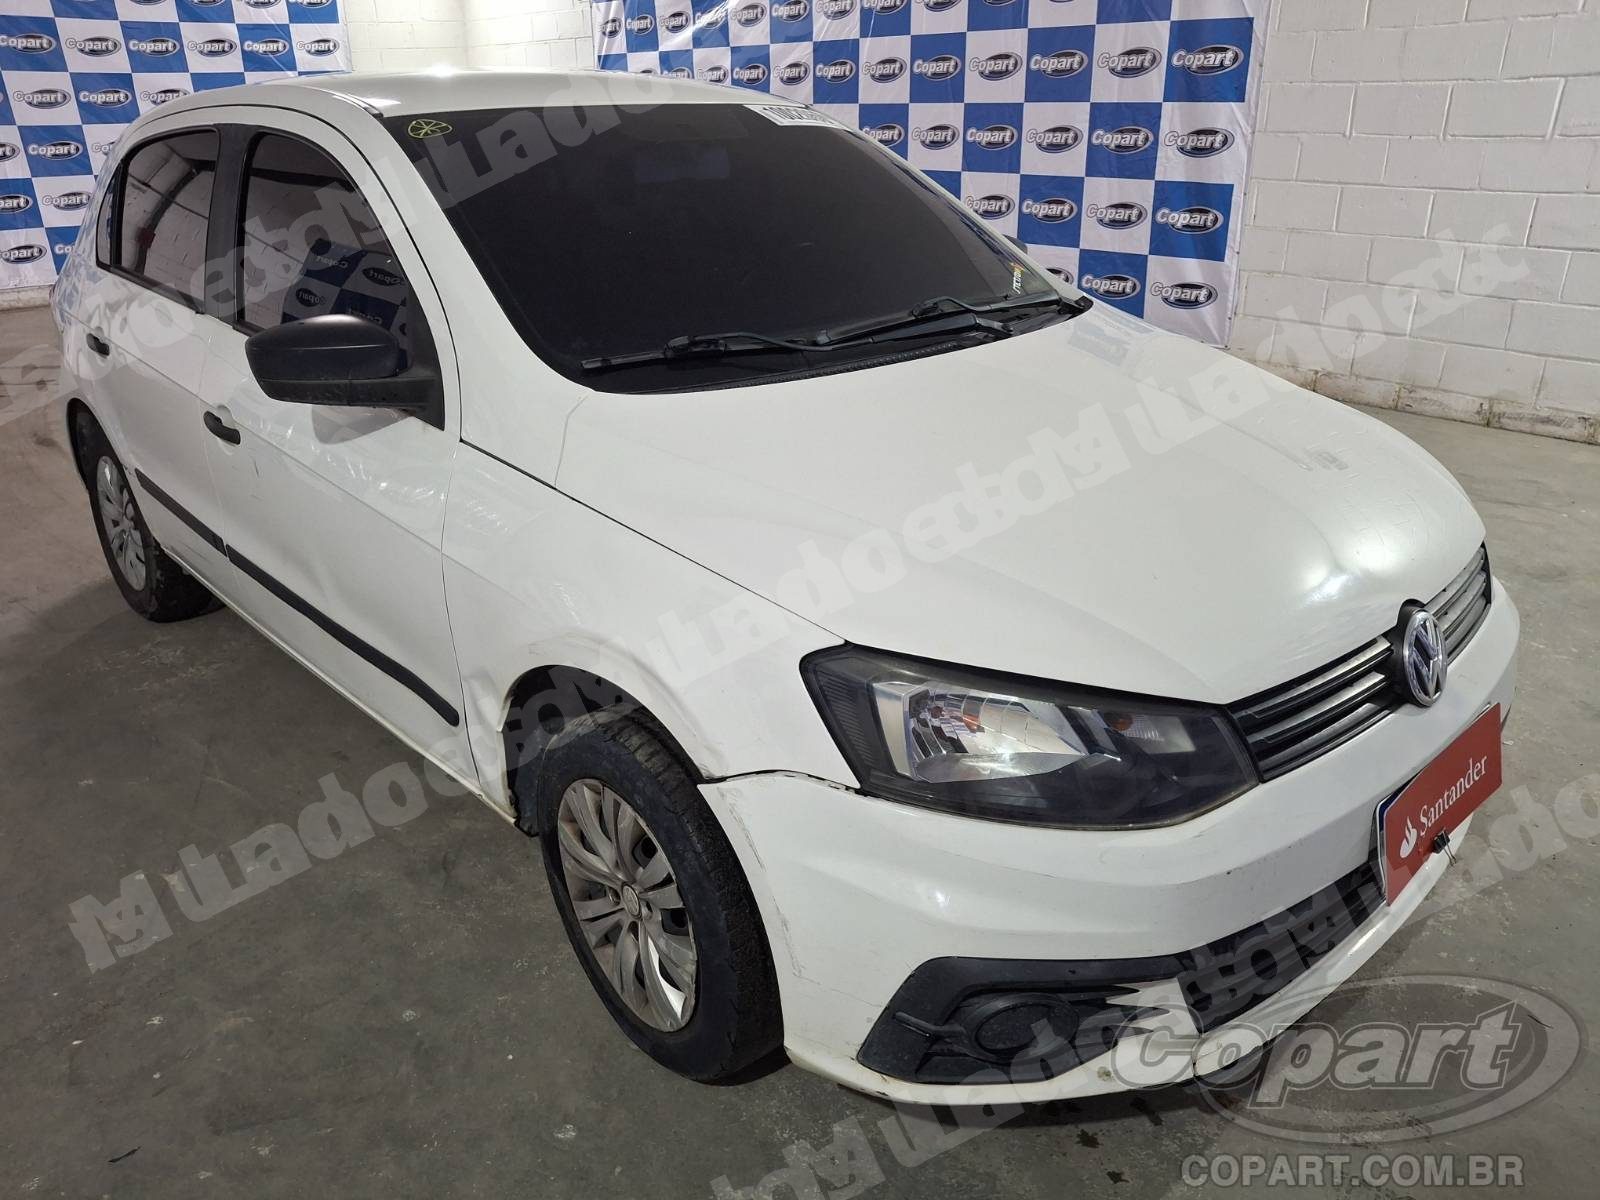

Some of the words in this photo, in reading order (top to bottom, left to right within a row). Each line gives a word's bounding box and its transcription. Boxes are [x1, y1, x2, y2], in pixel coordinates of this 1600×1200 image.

[730, 7, 763, 22] Copart
[771, 4, 805, 18] Copart
[659, 14, 687, 30] Copart
[0, 35, 49, 50] Copart
[65, 37, 114, 52] Copart
[128, 39, 174, 52] Copart
[187, 40, 230, 53] Copart
[243, 40, 283, 53] Copart
[297, 40, 335, 53] Copart
[913, 59, 955, 76] Copart
[969, 57, 1015, 75] Copart
[1030, 53, 1082, 72] Copart
[1097, 51, 1151, 71] Copart
[1172, 49, 1234, 69] Copart
[697, 68, 724, 81] Copart
[733, 67, 763, 81] Copart
[773, 65, 805, 82] Copart
[815, 62, 850, 79] Copart
[862, 61, 901, 78] Copart
[13, 90, 63, 105] Copart
[79, 91, 127, 104] Copart
[140, 90, 183, 102] Copar
[912, 127, 953, 144] Copart
[967, 127, 1012, 145] Copart
[1026, 129, 1075, 147] Copart
[1091, 129, 1146, 149] Copart
[1164, 130, 1224, 149] Copart
[28, 143, 77, 157] Copart
[42, 192, 88, 207] Copart
[966, 196, 1009, 213] Copart
[1021, 198, 1072, 218] Copart
[1087, 203, 1140, 222] Copart
[1155, 207, 1216, 228] Copart
[0, 247, 40, 260] opart
[1081, 275, 1134, 294] Copart
[1150, 281, 1209, 302] Copart
[1418, 755, 1488, 837] Santander
